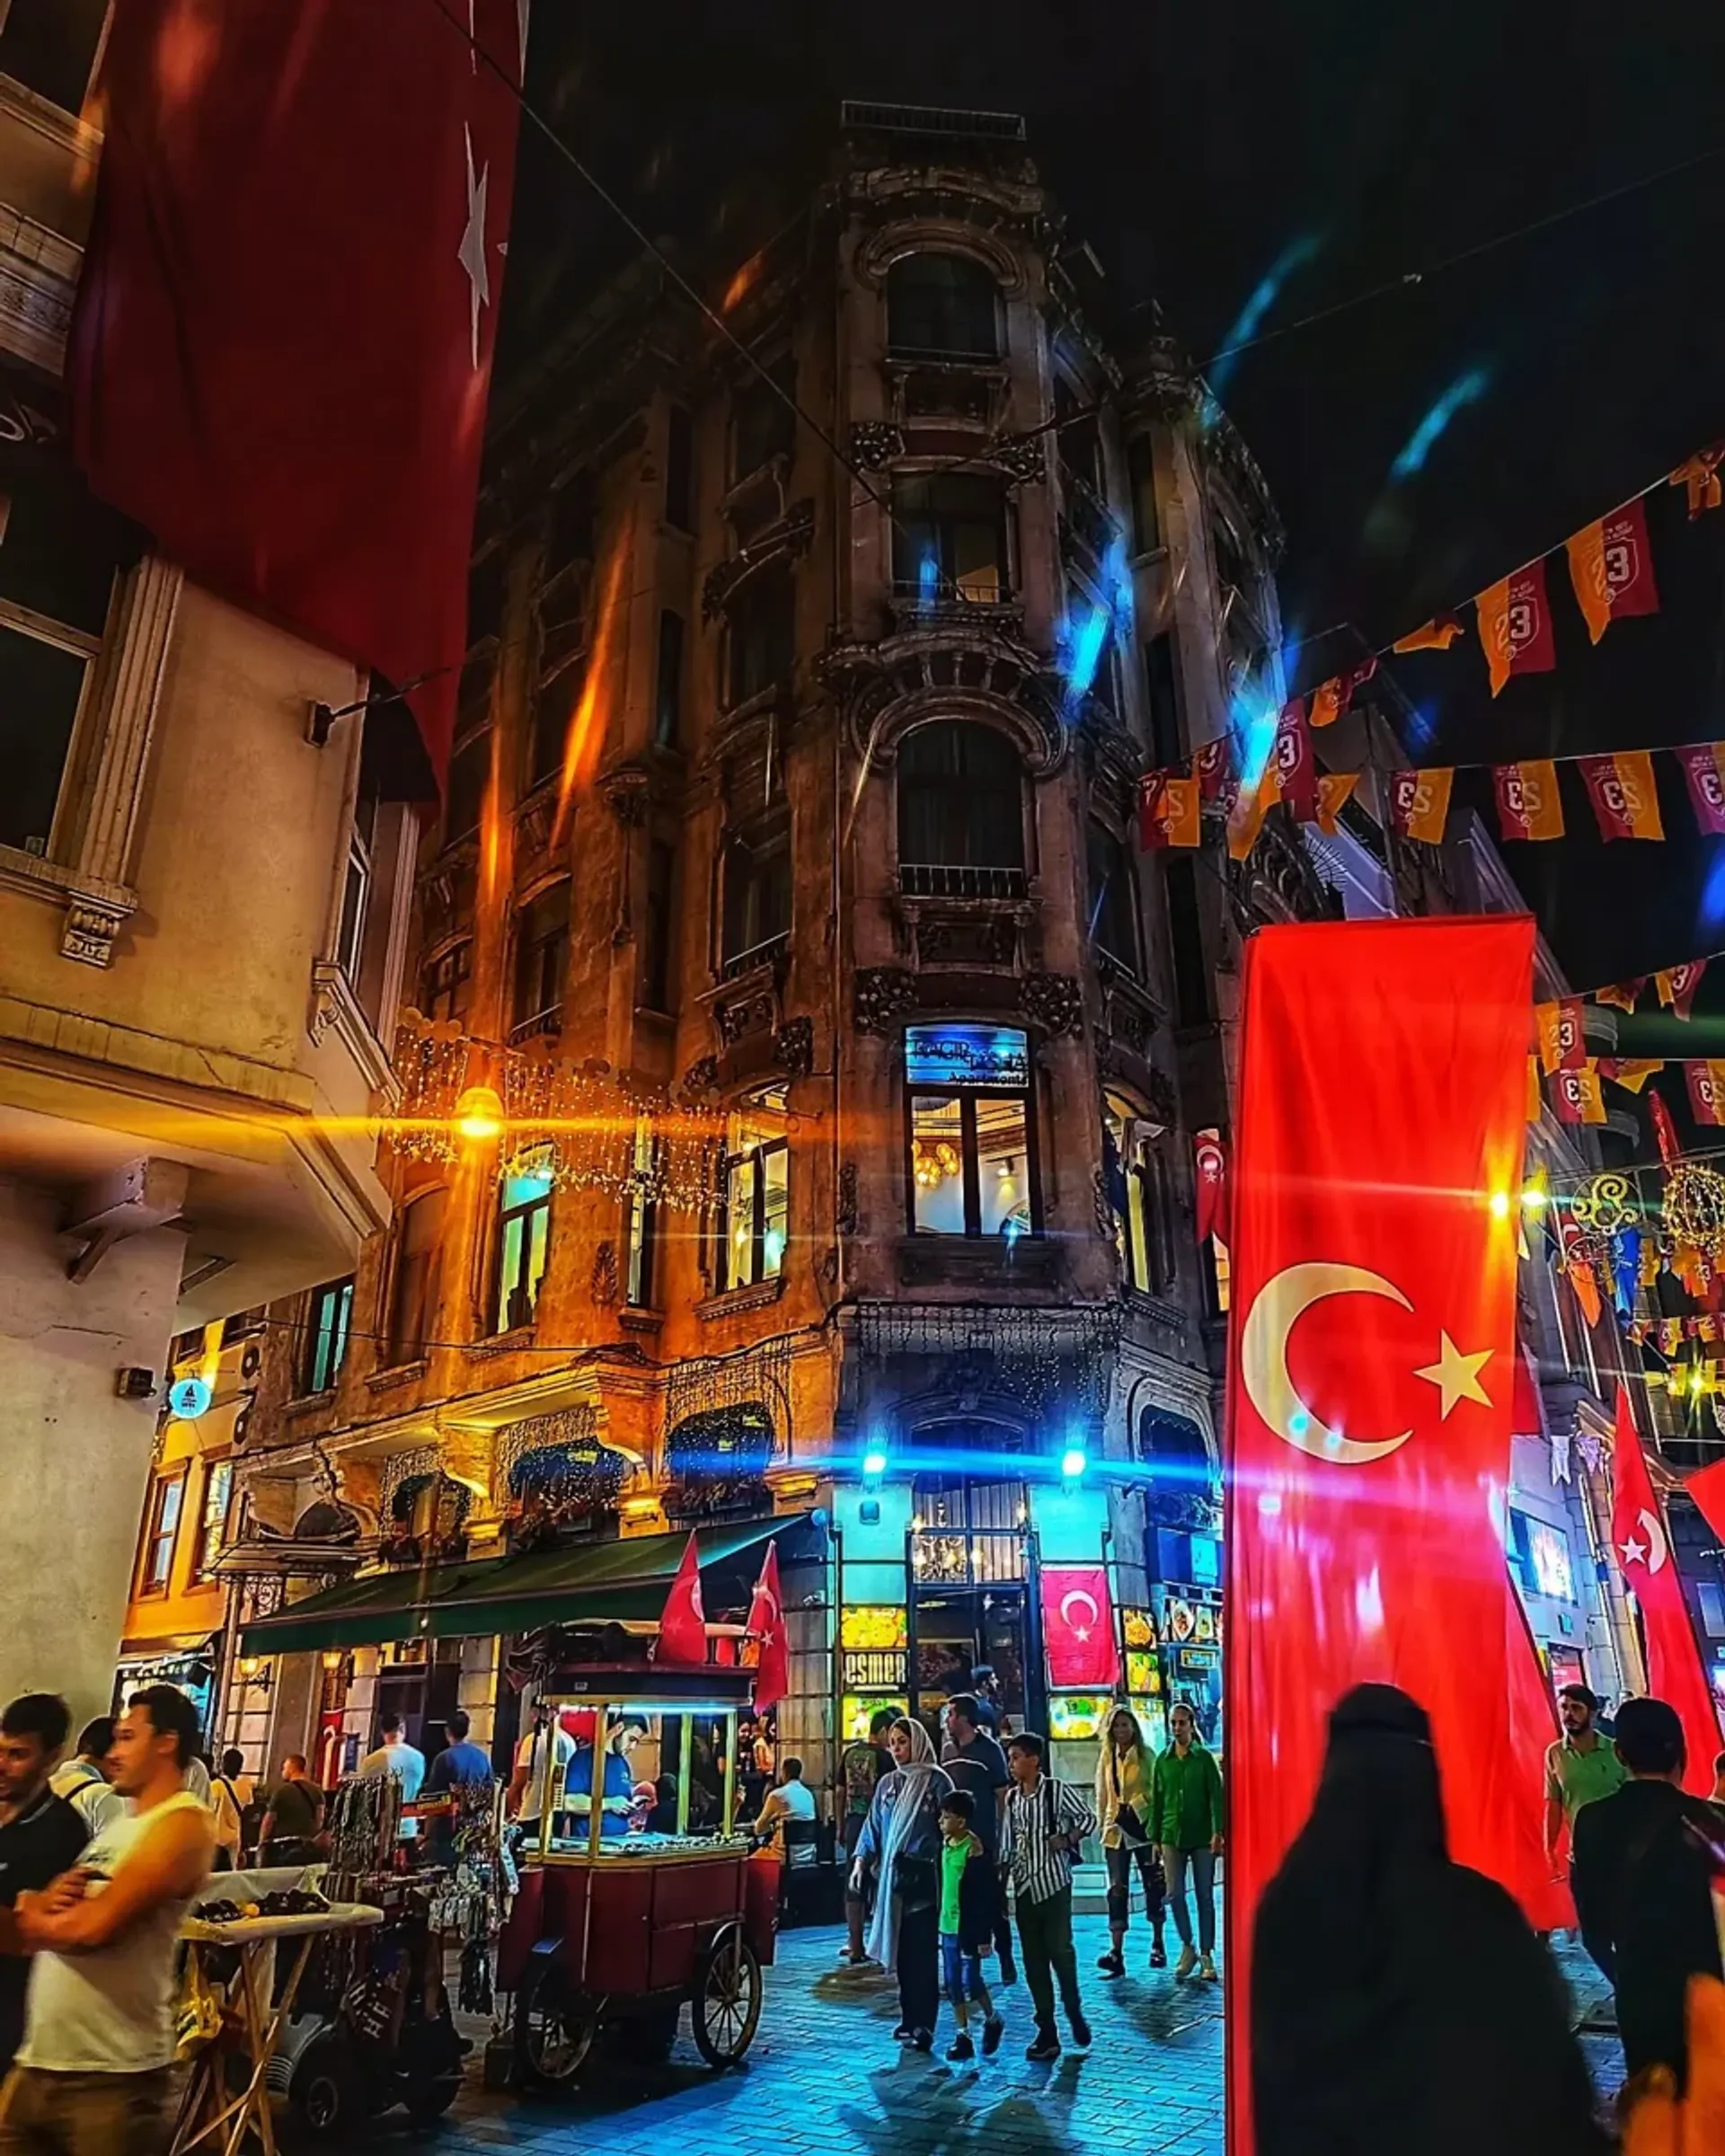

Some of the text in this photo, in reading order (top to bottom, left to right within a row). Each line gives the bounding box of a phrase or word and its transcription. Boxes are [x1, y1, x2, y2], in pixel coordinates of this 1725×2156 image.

[1588, 546, 1630, 597] 23
[1495, 605, 1531, 649] 23
[1549, 1022, 1573, 1047] 23
